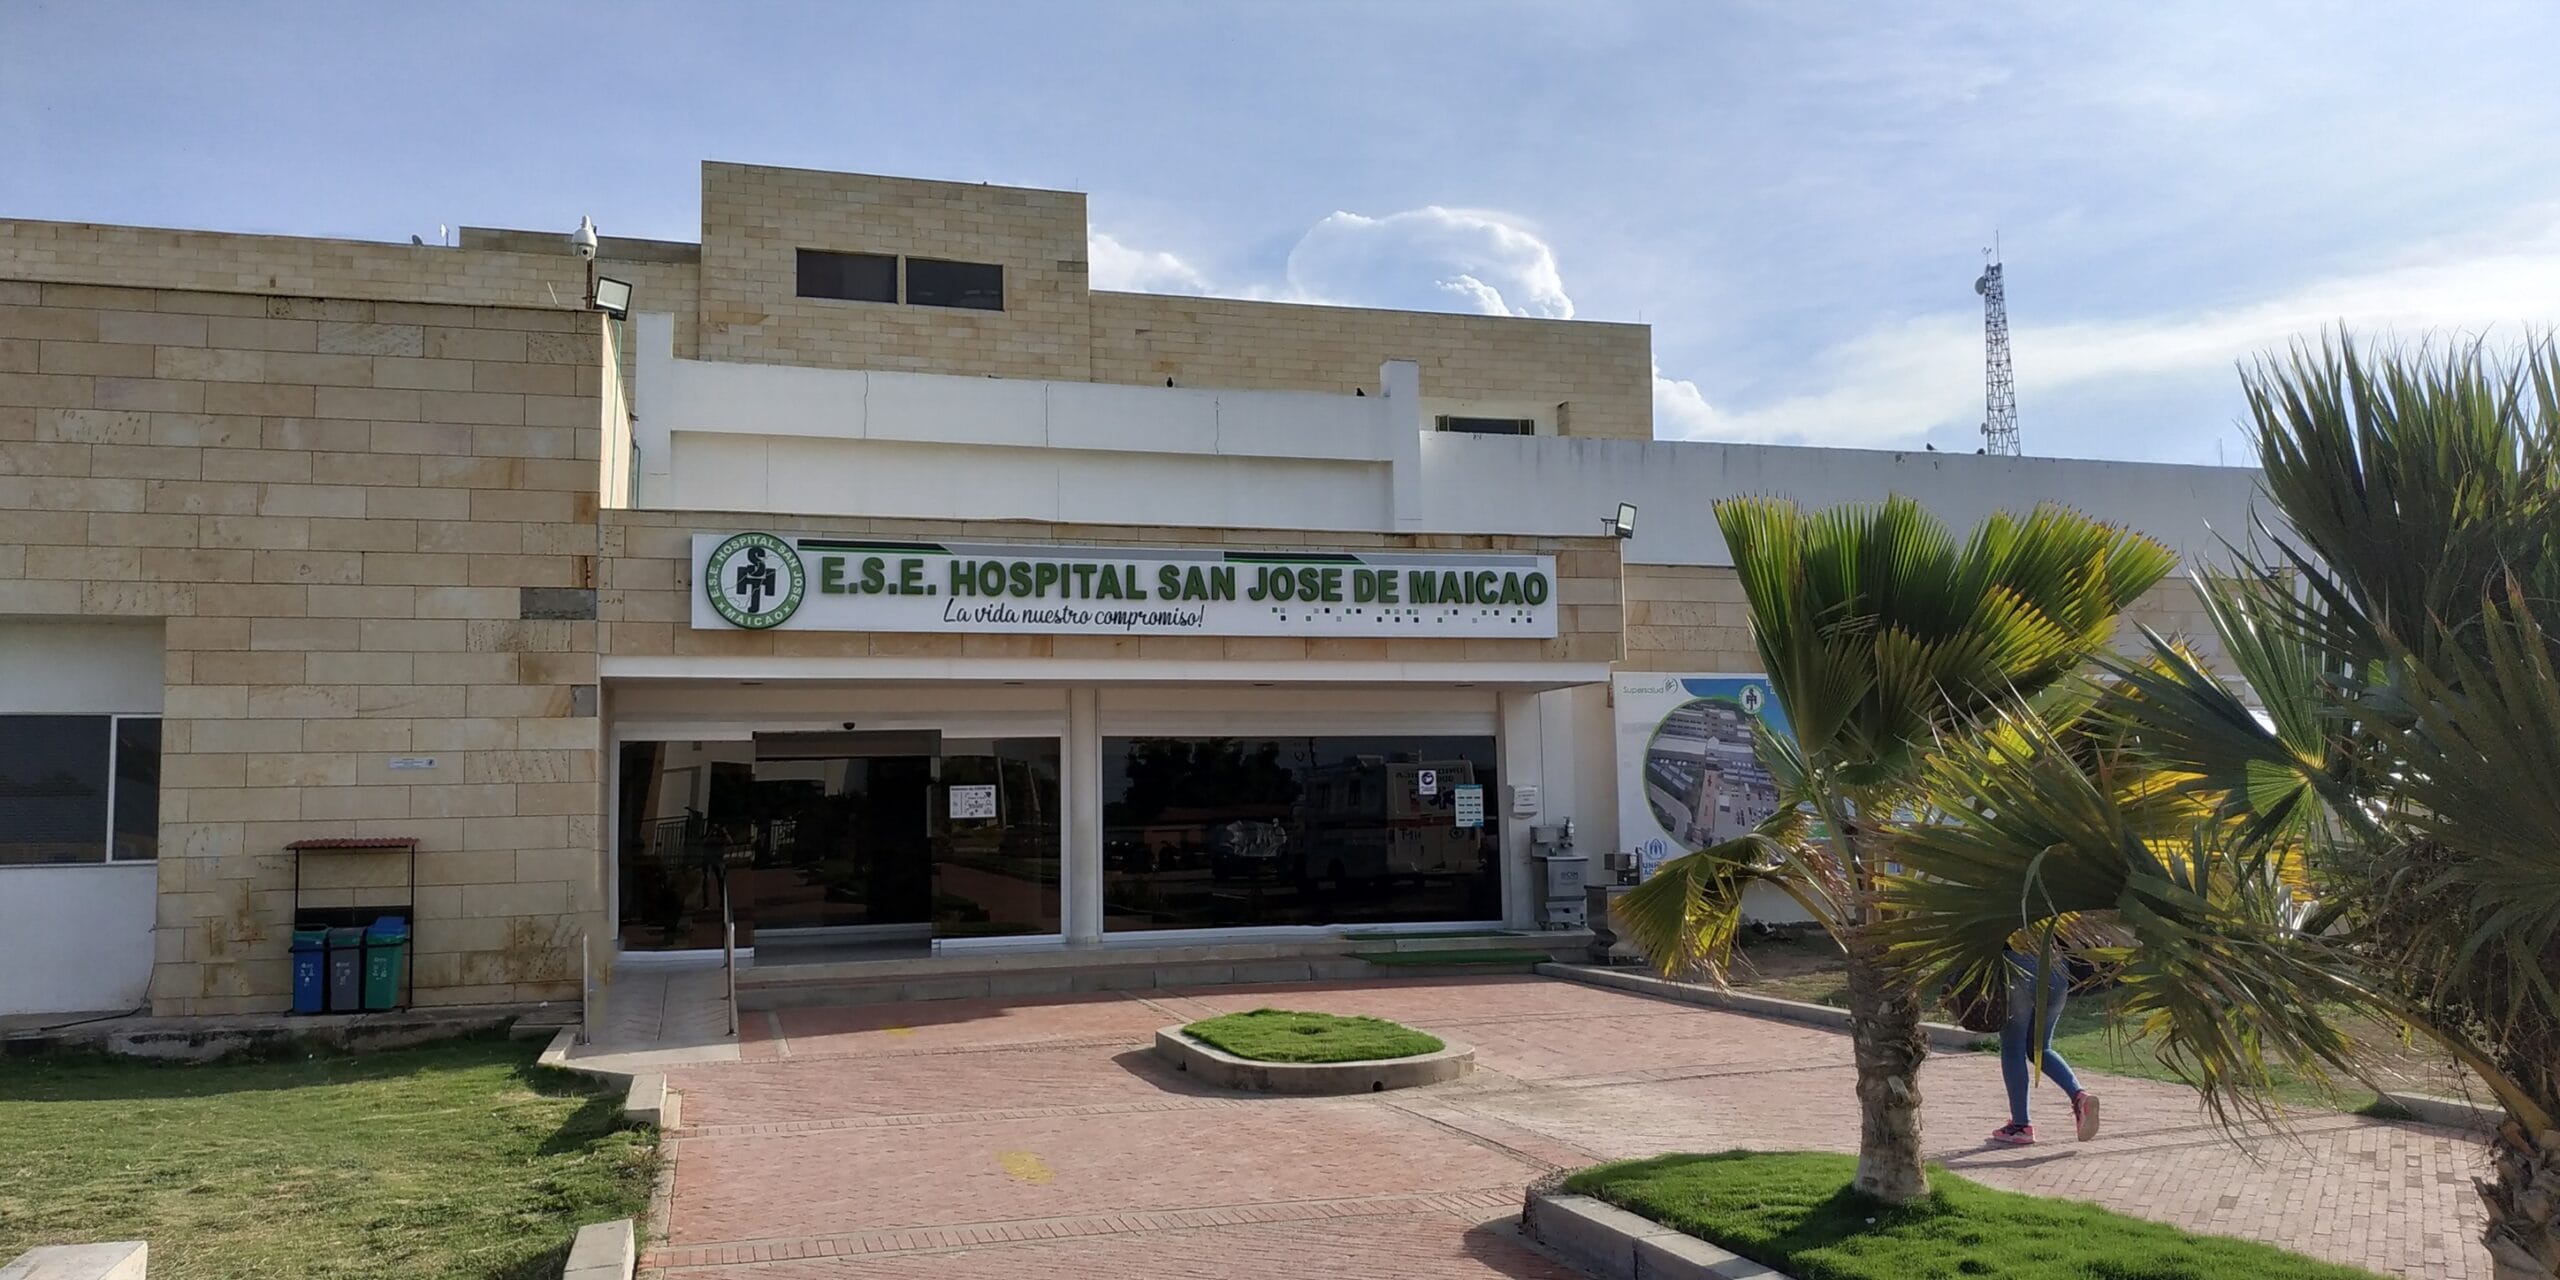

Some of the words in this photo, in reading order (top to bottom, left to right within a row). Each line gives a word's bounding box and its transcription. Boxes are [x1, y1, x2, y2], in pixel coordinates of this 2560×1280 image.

[708, 564, 721, 598] E.S.E.
[716, 535, 775, 562] HOSPITAL
[777, 544, 799, 568] SAN
[789, 570, 803, 603] JOSE
[821, 556, 937, 596] E.S.E.
[950, 559, 1148, 601] HOSPITAL
[1158, 564, 1236, 602] SAN
[1247, 566, 1343, 603] JOSE
[1353, 568, 1399, 604] DE
[1408, 570, 1549, 607] MAICAO
[724, 607, 783, 626] MAICAO
[943, 597, 972, 624] La
[974, 602, 1020, 624] vida
[1021, 604, 1094, 626] nuestro
[1094, 604, 1206, 631] compromiso!
[1623, 686, 1664, 695] Supersalud
